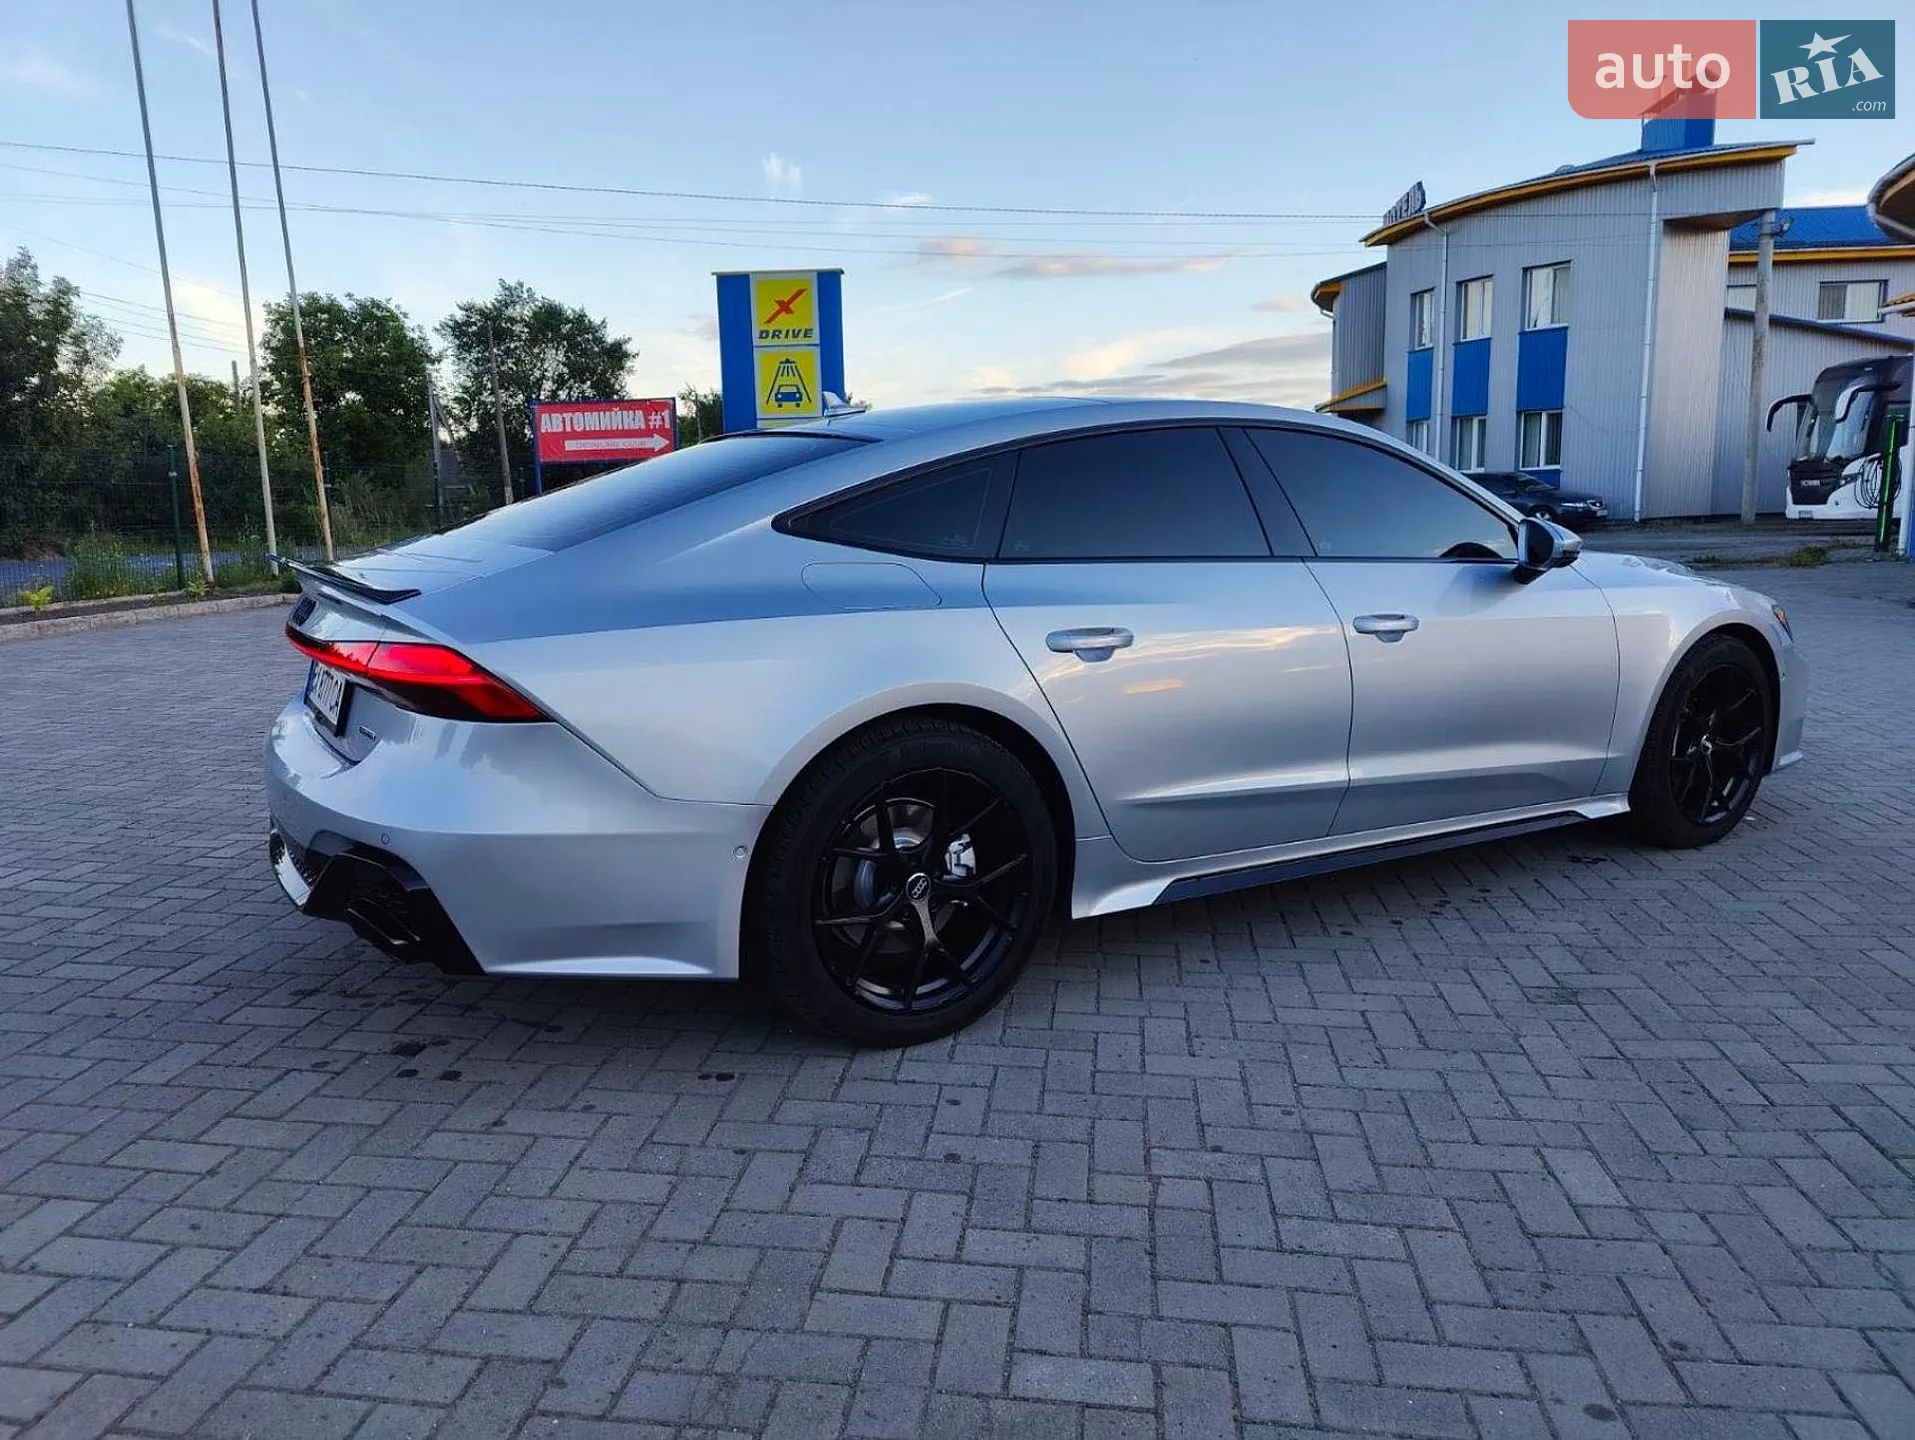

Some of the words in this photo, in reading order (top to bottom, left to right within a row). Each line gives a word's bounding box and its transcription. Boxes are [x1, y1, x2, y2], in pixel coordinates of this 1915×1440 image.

[757, 328, 813, 339] DRIVE
[541, 407, 646, 433] АВТОМИЙКА
[648, 410, 670, 429] #1
